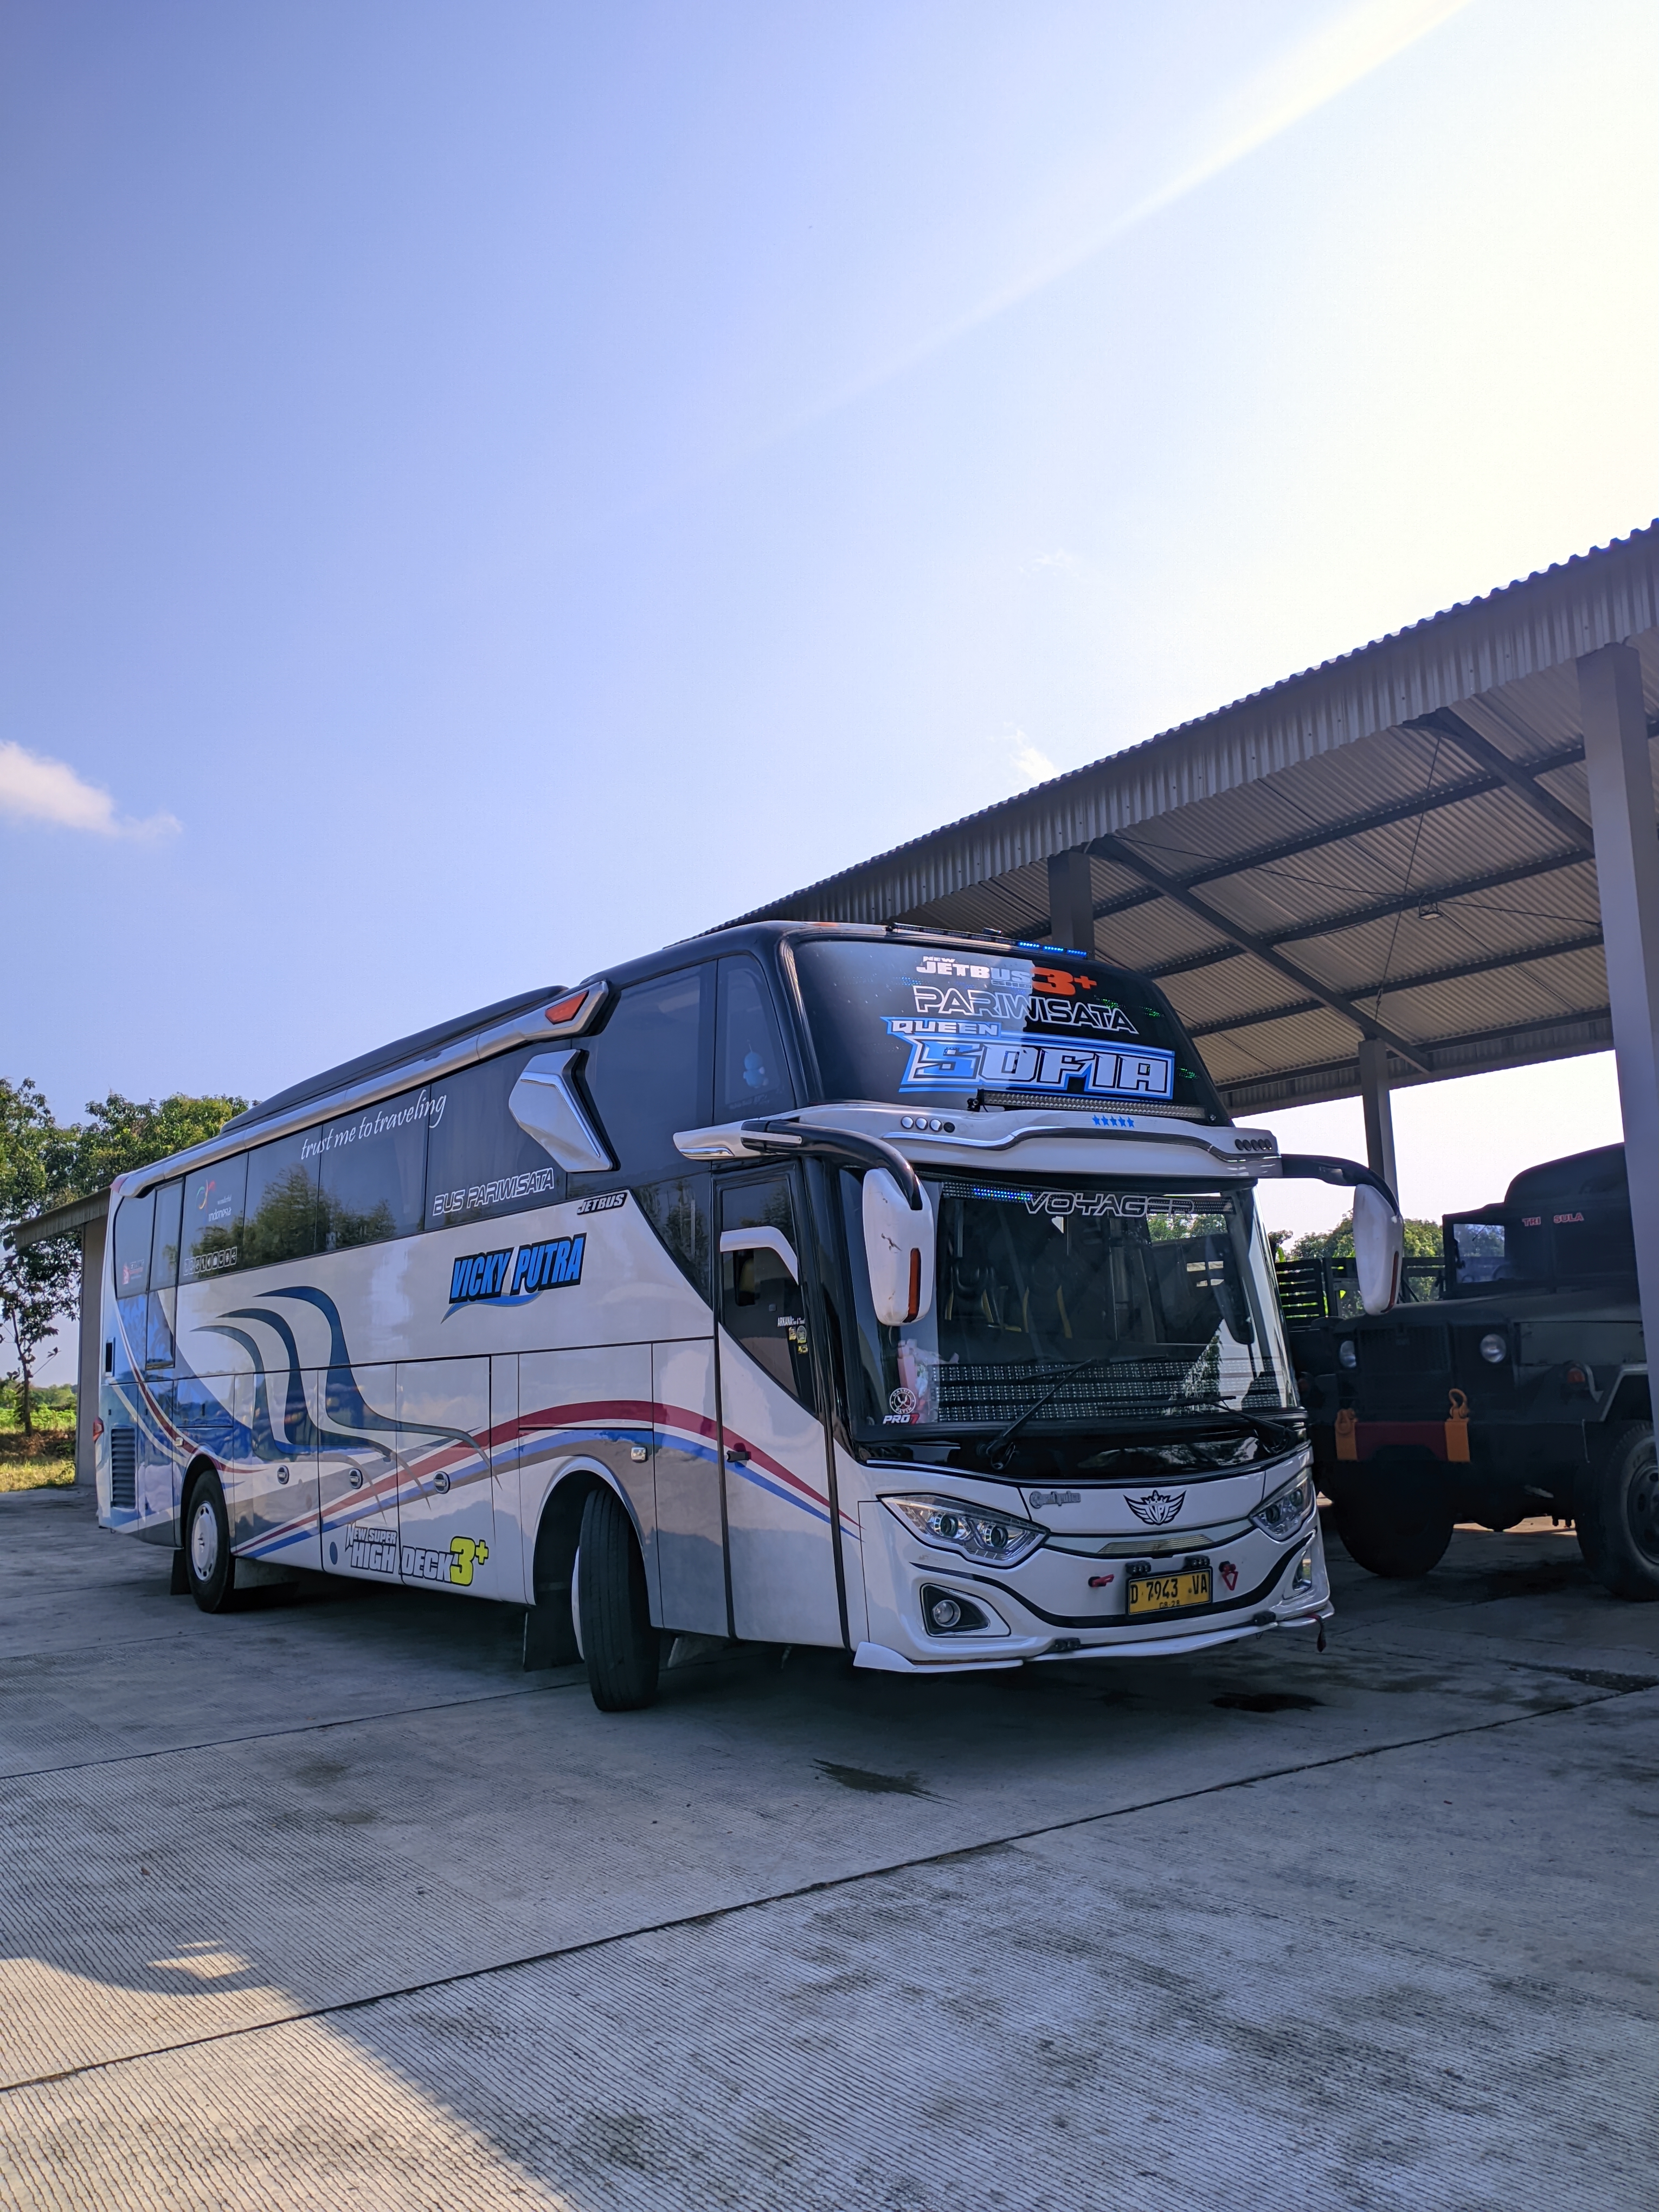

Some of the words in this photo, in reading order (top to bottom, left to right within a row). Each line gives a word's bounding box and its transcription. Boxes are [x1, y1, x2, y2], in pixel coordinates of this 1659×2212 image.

[916, 961, 1033, 983] JETBUS
[913, 985, 1139, 1034] PARIWISATA
[892, 1019, 999, 1036] QUEEN
[908, 1036, 1170, 1095] SOFIA
[301, 1129, 334, 1160] trust
[334, 1128, 356, 1148] me
[358, 1116, 372, 1139] to
[374, 1089, 447, 1134] traveling
[433, 1189, 464, 1216] BUS
[466, 1167, 555, 1210] PARIWISATA
[578, 1193, 626, 1214] JETBUS
[1024, 1191, 1195, 1219] VOYAGER
[1522, 1217, 1541, 1226] TRI
[1553, 1212, 1584, 1224] SULA
[450, 1249, 511, 1301] VICKY
[512, 1235, 586, 1293] PUTRA
[345, 1521, 368, 1549] NEW
[368, 1528, 397, 1545] SUPER
[351, 1541, 397, 1574] HIGH
[400, 1546, 455, 1583] DECK
[1130, 1584, 1138, 1604] D
[1146, 1578, 1178, 1602] 7943
[1192, 1574, 1207, 1594] VA
